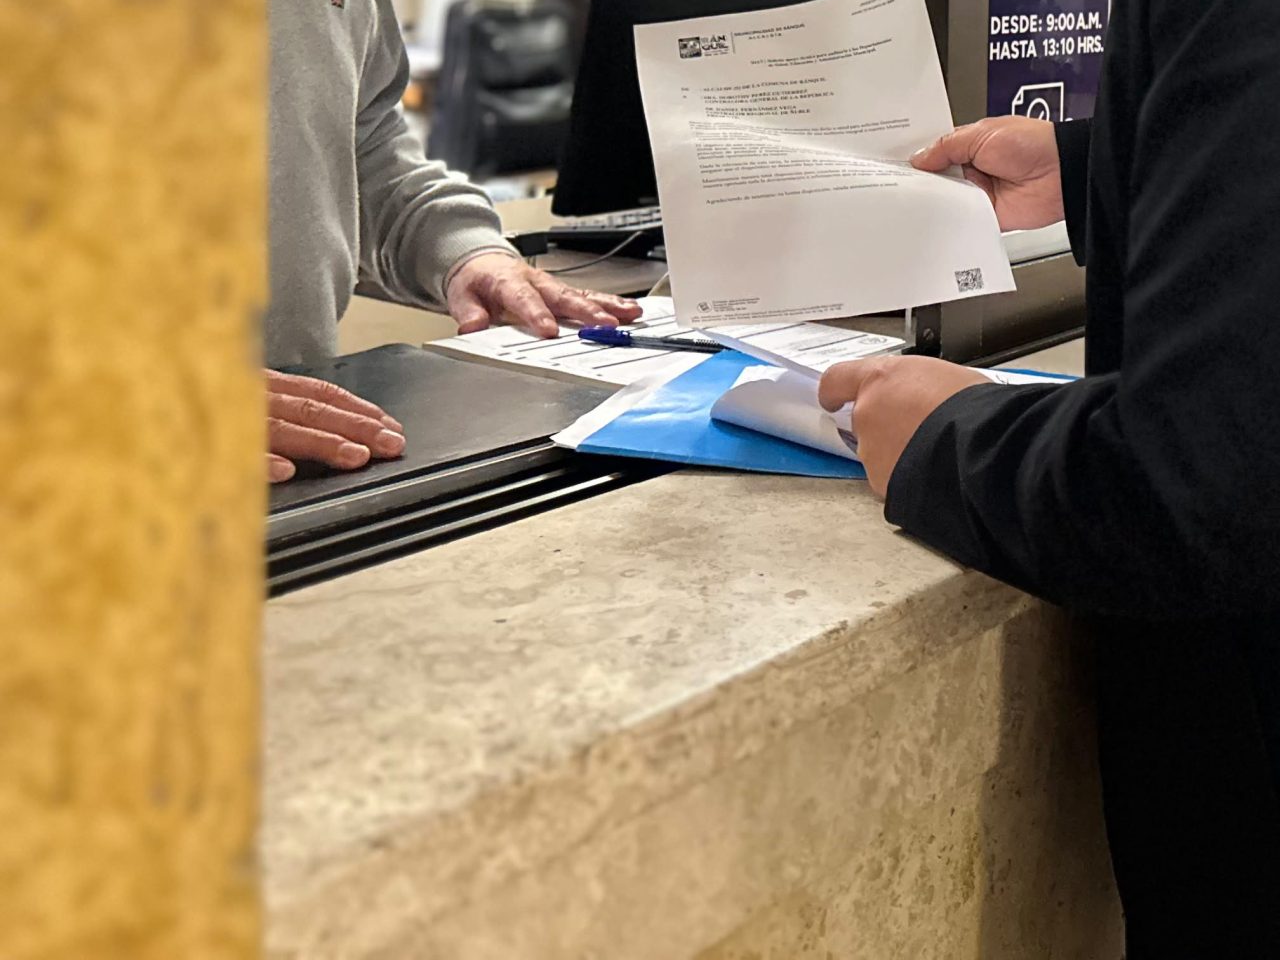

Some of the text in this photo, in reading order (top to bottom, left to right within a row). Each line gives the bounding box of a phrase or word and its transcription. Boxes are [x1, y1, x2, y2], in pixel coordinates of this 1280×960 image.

[991, 12, 1102, 34] DESDE: 9:00 A.M.
[990, 35, 1104, 60] HASTA 13:10 HRS.
